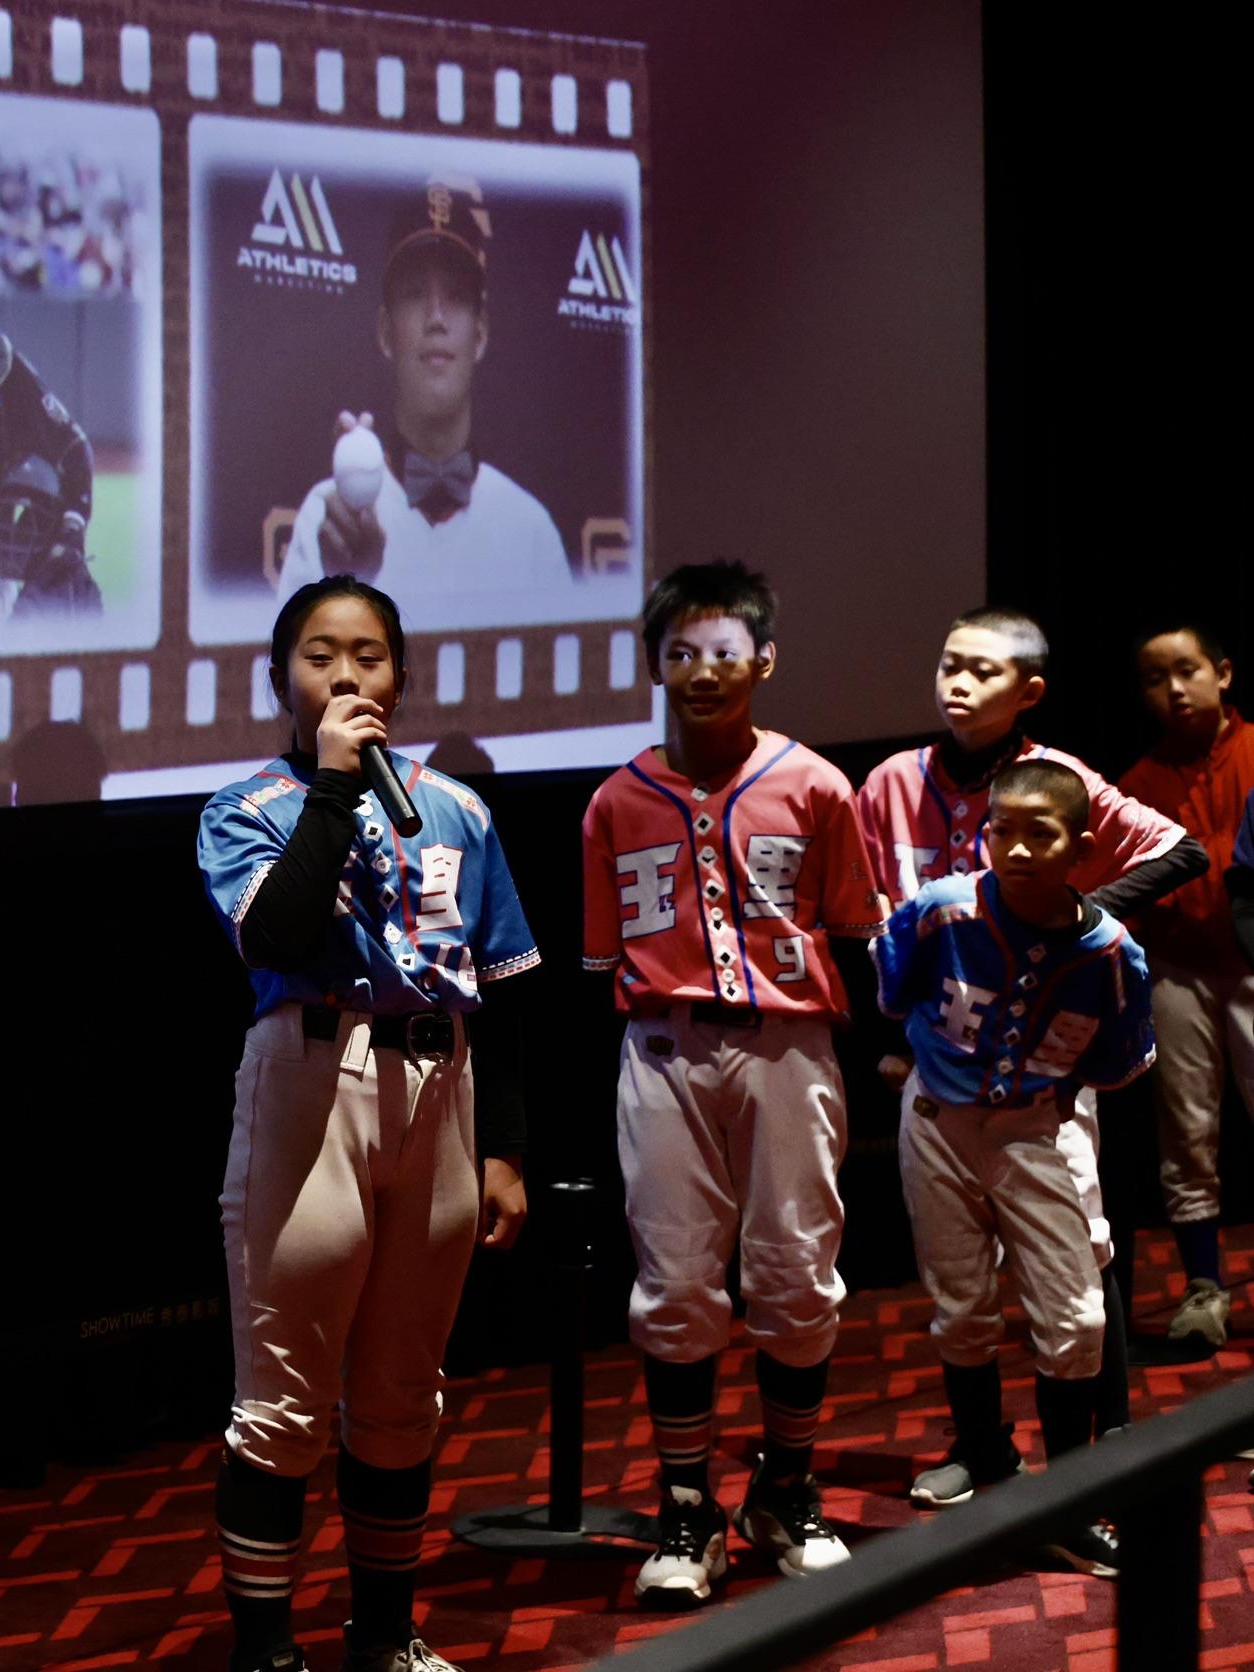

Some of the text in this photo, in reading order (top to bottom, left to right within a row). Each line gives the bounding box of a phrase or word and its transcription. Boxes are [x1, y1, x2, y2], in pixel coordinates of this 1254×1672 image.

[237, 246, 357, 284] ATHLETICS
[773, 934, 806, 982] 9
[79, 1303, 155, 1339] SHOWTIME
